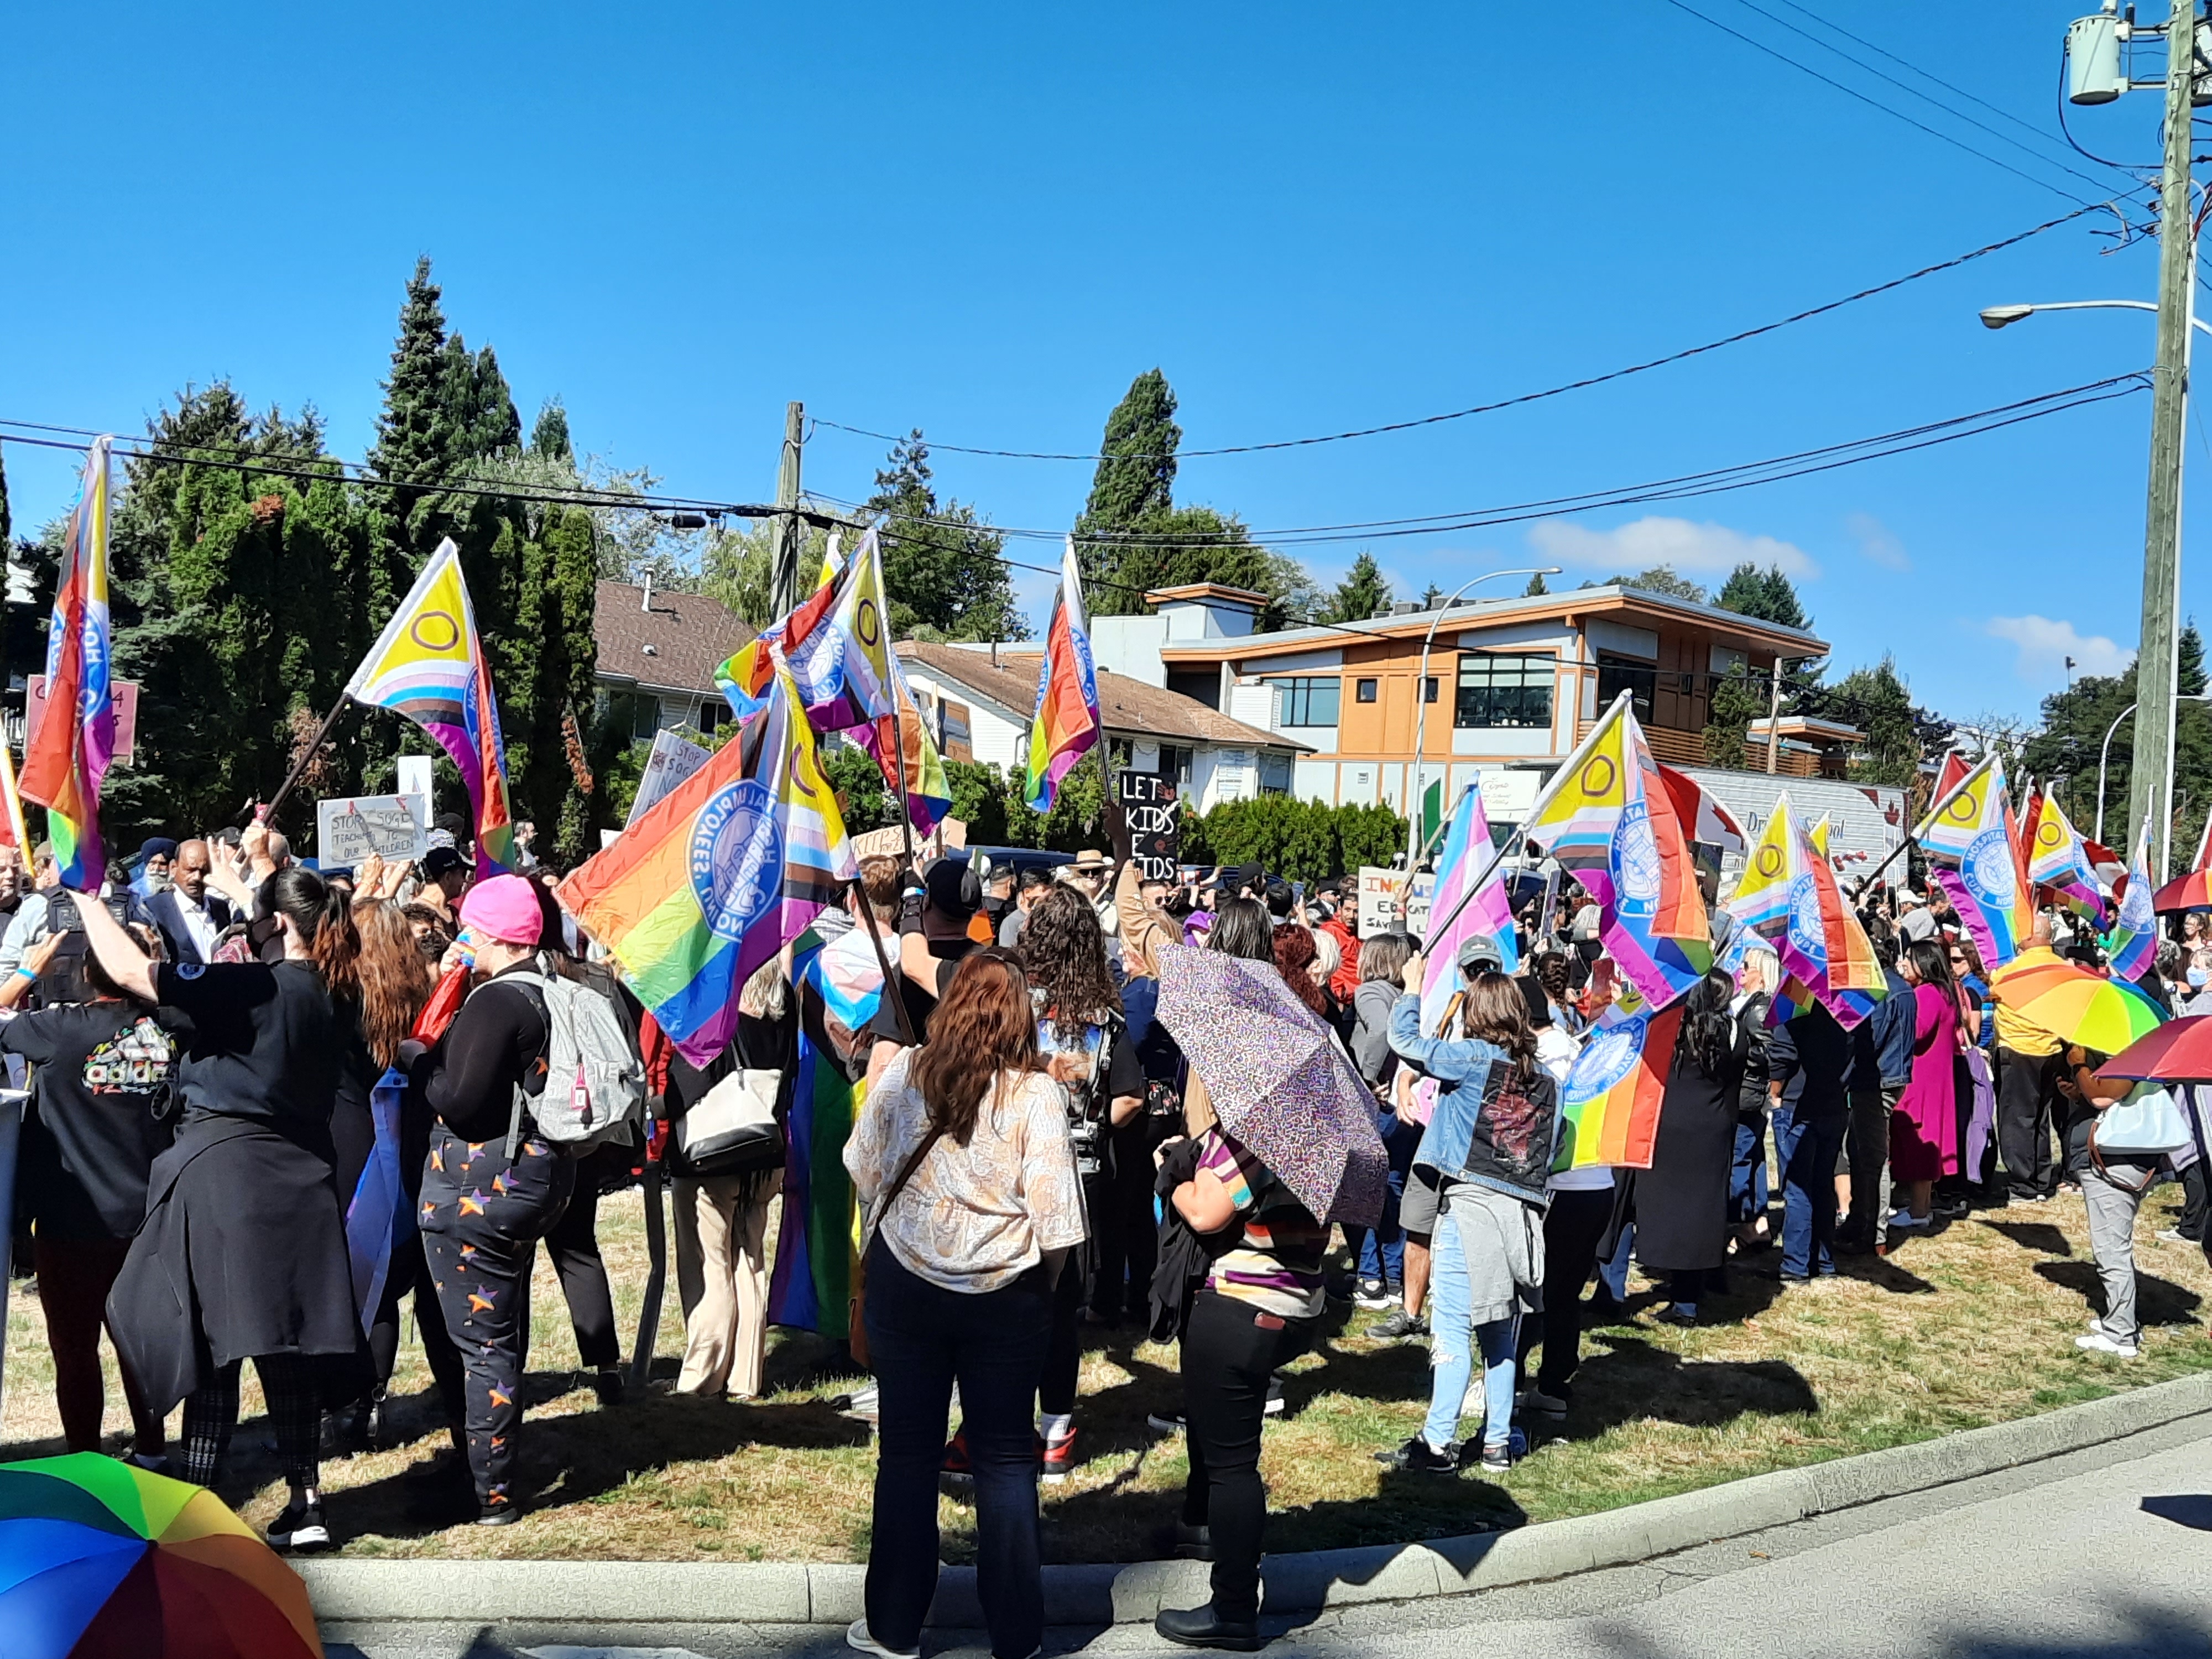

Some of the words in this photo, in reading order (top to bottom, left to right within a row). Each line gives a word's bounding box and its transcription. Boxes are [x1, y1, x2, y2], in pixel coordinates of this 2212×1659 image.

[667, 758, 695, 777] SOG
[676, 744, 701, 765] STOP
[1123, 774, 1162, 801] LET
[344, 847, 359, 858] OUR
[1966, 831, 2006, 862] HOSPITAL
[1133, 857, 1175, 880] IDS
[1791, 875, 1814, 915] HOSPIT
[1965, 873, 1987, 900] CUPE
[1791, 928, 1817, 954] CUPE
